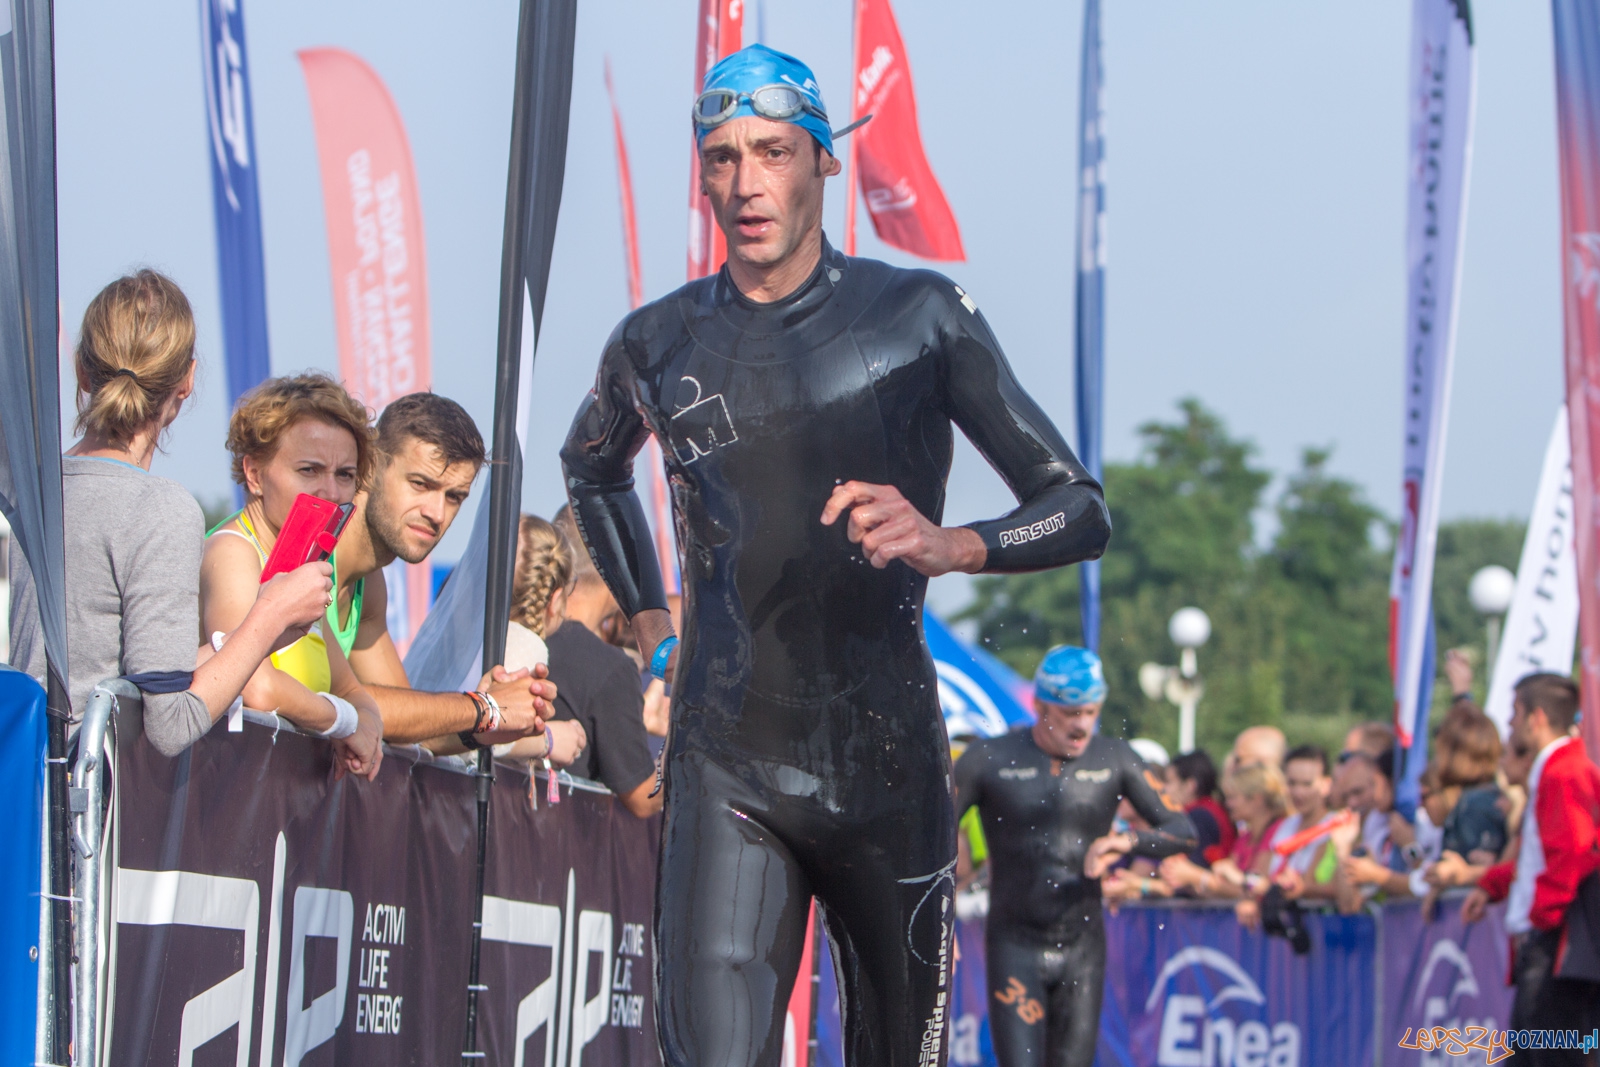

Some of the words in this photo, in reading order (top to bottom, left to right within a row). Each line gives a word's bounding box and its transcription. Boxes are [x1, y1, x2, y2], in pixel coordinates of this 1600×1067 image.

[358, 947, 390, 989] LIFE
[938, 921, 949, 987] Aqua
[355, 993, 403, 1035] ENERG
[1157, 993, 1302, 1067] Enea
[908, 1017, 926, 1067] POWE
